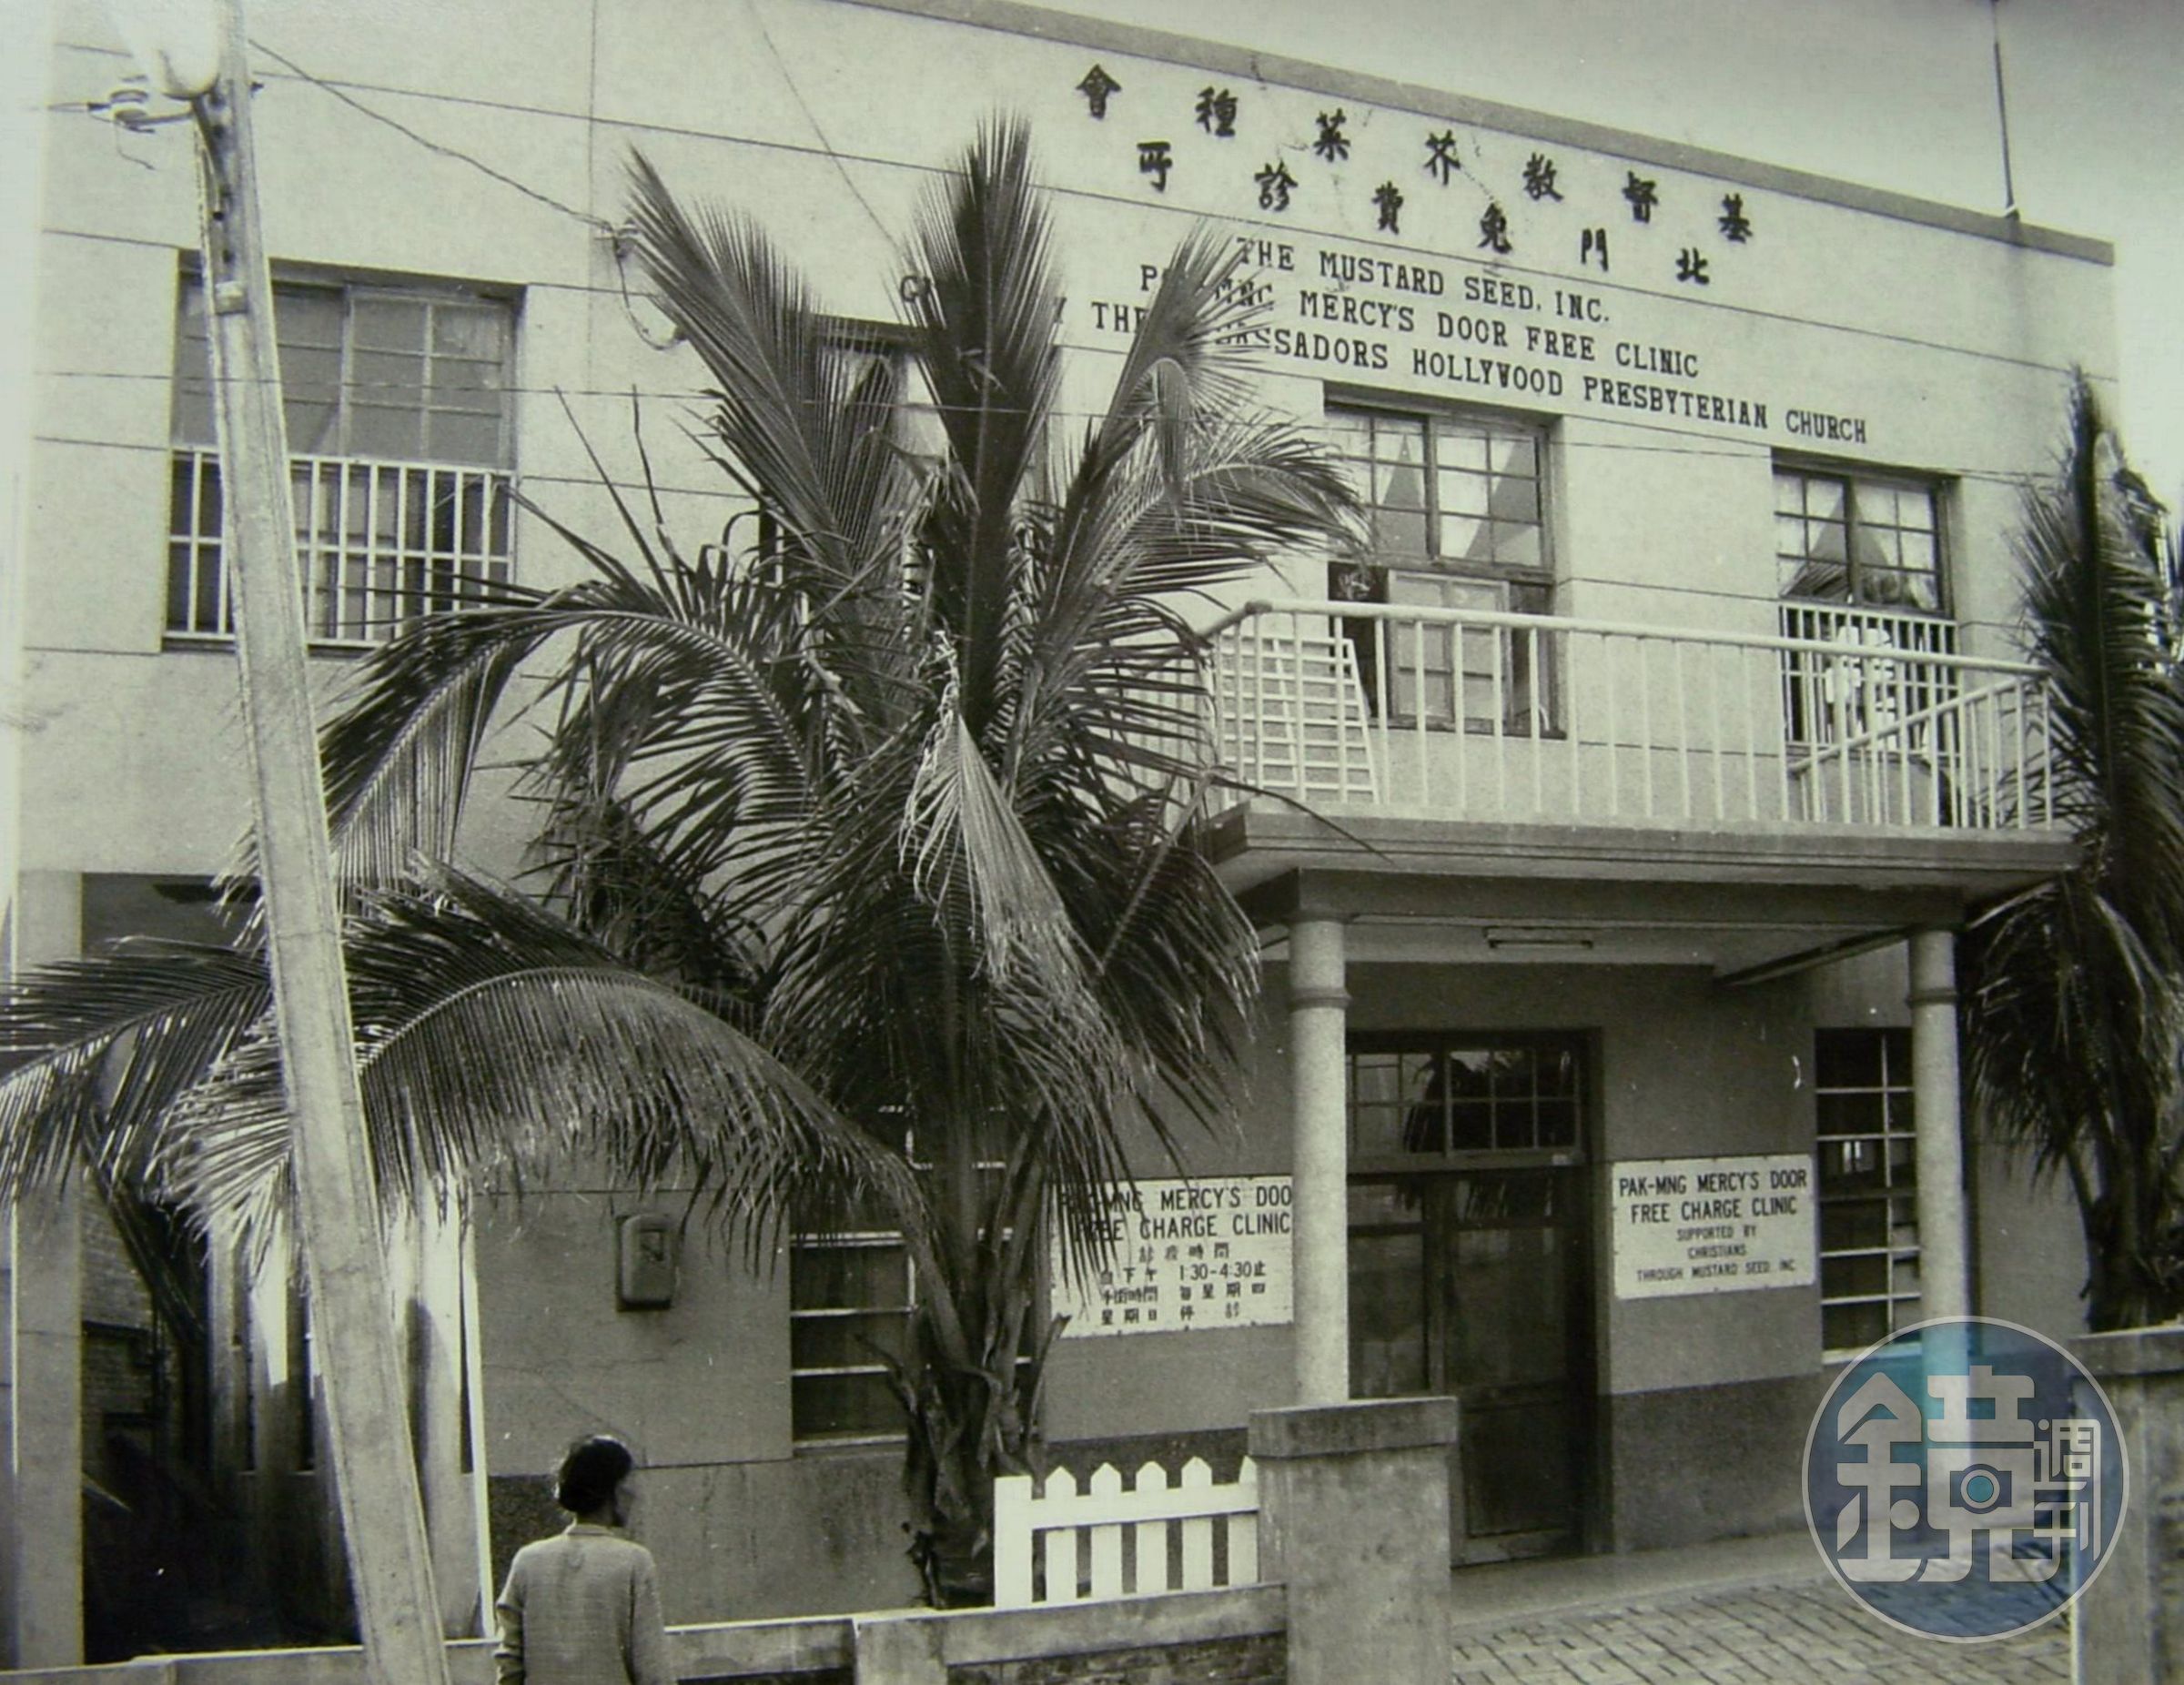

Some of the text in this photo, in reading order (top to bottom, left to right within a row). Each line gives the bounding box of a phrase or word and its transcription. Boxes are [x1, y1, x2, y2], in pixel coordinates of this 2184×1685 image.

[1237, 237, 1294, 271] THE
[1320, 250, 1443, 296] MUSTARD
[1554, 290, 1609, 322] INC.
[1299, 290, 1414, 332] MERCY'S
[1437, 311, 1508, 347] DOOR
[1525, 326, 1595, 361] FREE
[1615, 342, 1699, 378] CLINIC
[1412, 348, 1563, 397] HOLLYWOOD
[1582, 375, 1768, 429] PRESBYTERIAN
[1785, 409, 1866, 444] CHURCH
[1620, 1169, 1807, 1197] PAK-MNG MERCY'S DOOR
[1161, 1186, 1240, 1212] MERCY'S
[1632, 1196, 1797, 1225] FREE CHARGE CLINIC
[1139, 1215, 1217, 1240] CHARGE
[1232, 1212, 1290, 1236] CLINIC
